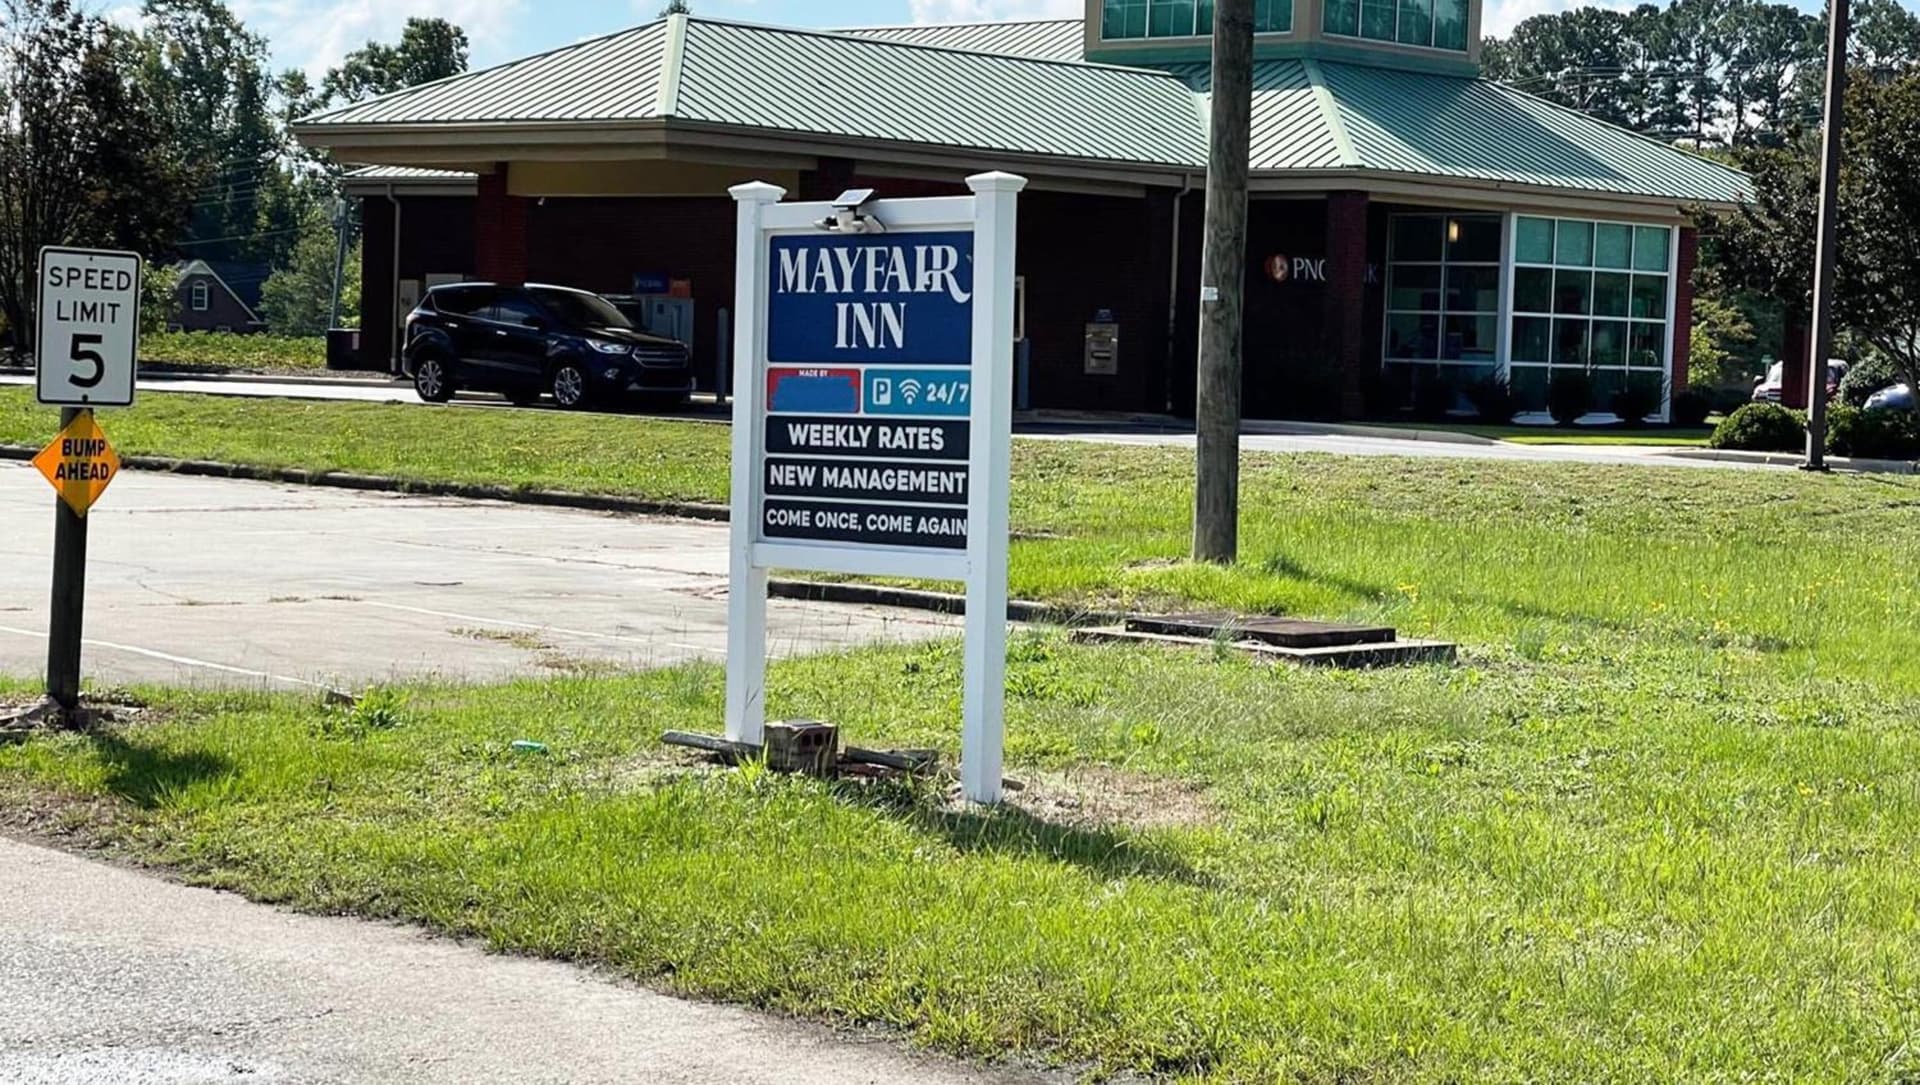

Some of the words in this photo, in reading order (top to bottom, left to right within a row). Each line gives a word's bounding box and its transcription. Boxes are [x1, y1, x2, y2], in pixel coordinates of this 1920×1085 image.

[49, 266, 131, 291] SPEED
[777, 245, 971, 303] MAYFAIR
[57, 299, 120, 324] LIMIT
[835, 302, 906, 348] INN
[68, 333, 105, 388] 5
[926, 382, 969, 405] 24/7
[62, 438, 105, 457] BUMP
[787, 423, 872, 448] WEEKLY
[879, 426, 944, 450] RATES
[55, 462, 109, 481] AHEAD
[770, 464, 816, 487] NEW
[822, 466, 966, 494] MANAGEMENT
[766, 508, 810, 527] COME
[815, 511, 862, 532] ONCE,
[866, 514, 912, 533] COME
[917, 517, 967, 536] AGAIN
